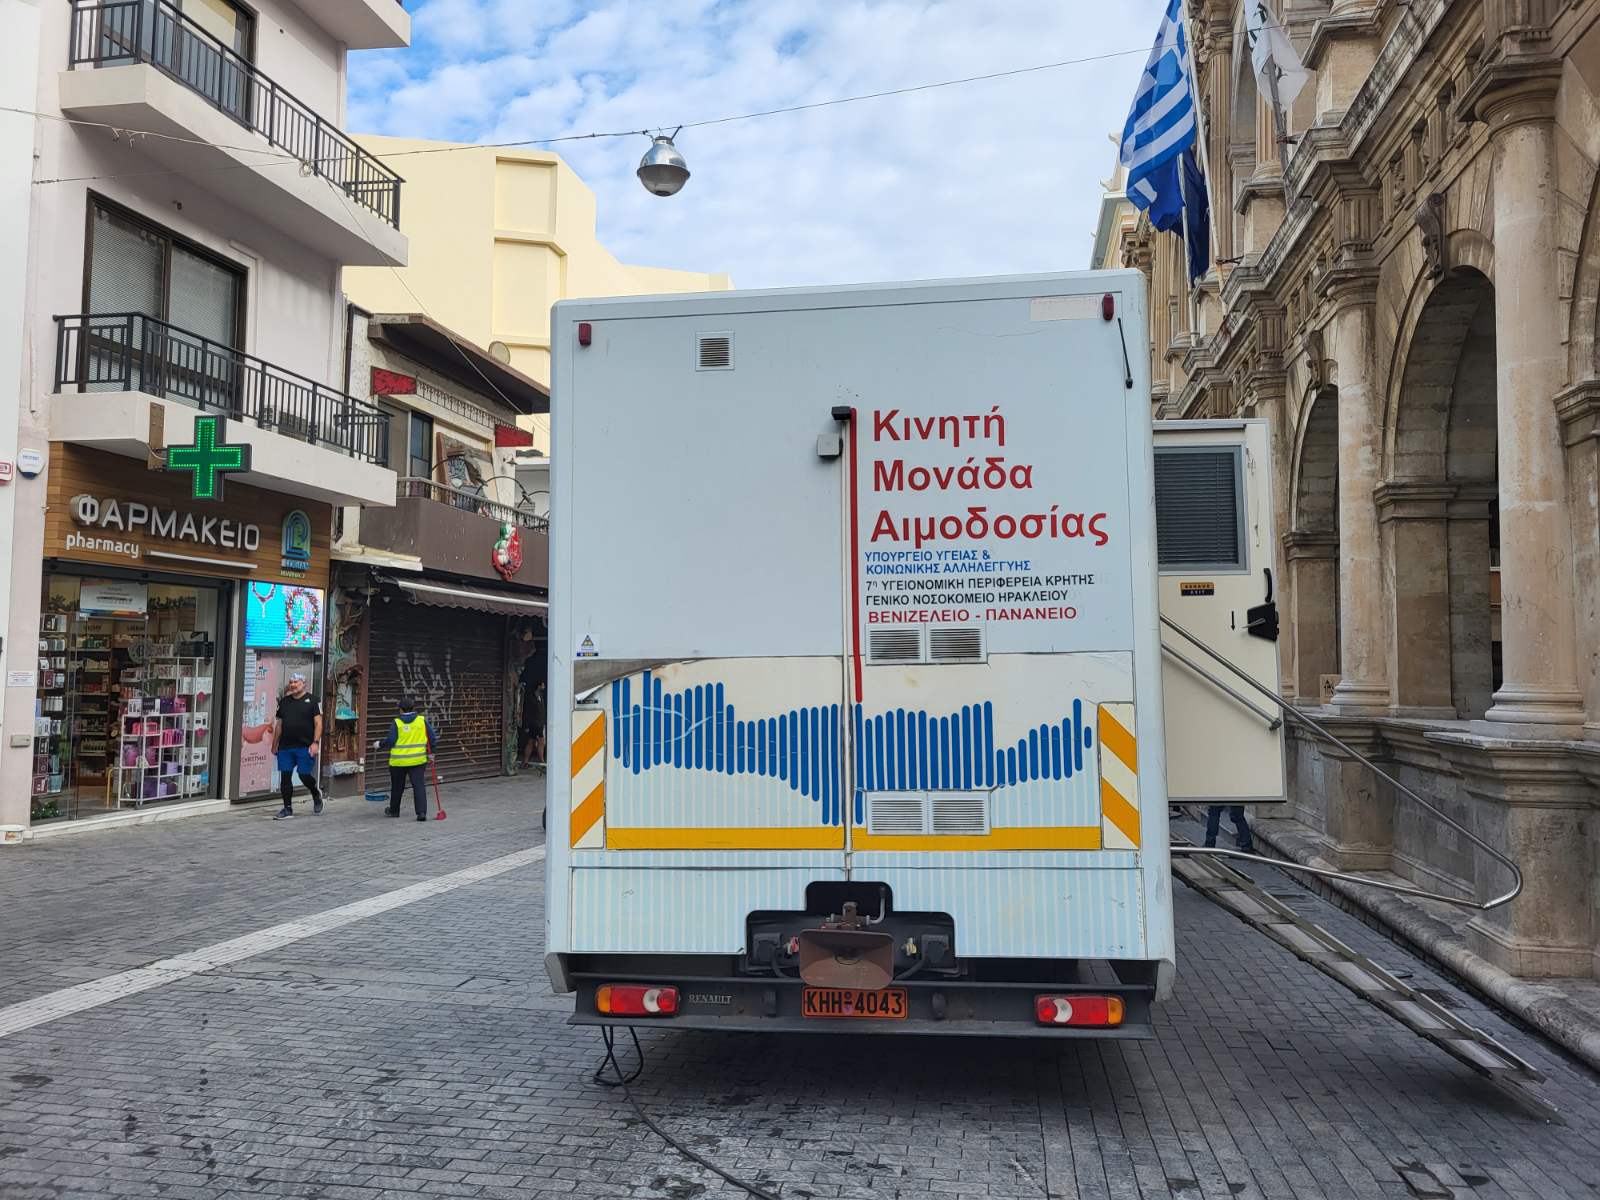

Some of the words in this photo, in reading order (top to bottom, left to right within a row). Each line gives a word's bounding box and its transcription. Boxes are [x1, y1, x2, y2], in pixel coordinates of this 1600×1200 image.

[873, 406, 1005, 447] Κινητή
[873, 457, 1033, 492] Μονάδα
[77, 495, 260, 551] ΦΑΡΜΑΚΕΙΟ
[870, 504, 1109, 549] Αιμοδοσίας
[66, 531, 140, 558] pharmacy
[865, 551, 933, 562] ΥΠΟΥΡΓΕΙΟ
[936, 550, 978, 561] ΥΓΕΙΑΣ
[982, 549, 991, 560] &
[866, 563, 941, 575] ΚΟΙΝΩΝΙΚΗΣ
[943, 560, 1031, 573] ΑΛΛΗΛΕΓΓΥΗΣ
[881, 578, 964, 591] ΥΓΕΙΟΝΟΜΙΚΗ
[968, 576, 1042, 589] ΠΕΡΙΦΕΡΕΙΑ
[1045, 574, 1095, 587] ΚΡΗΤΗΣ
[866, 595, 909, 606] ΓΕΝΙΚΟ
[913, 592, 995, 605] ΝΟΣΟΚΟΜΕΙΟ
[998, 590, 1068, 602] ΗΡΑΚΛΕΙΟΥ
[868, 609, 970, 623] ΒΕΝΙΖΕΛΕΙΟ
[986, 606, 1077, 621] ΠΑΝΑΝΕΙΟ
[689, 994, 732, 1004] RENAULT
